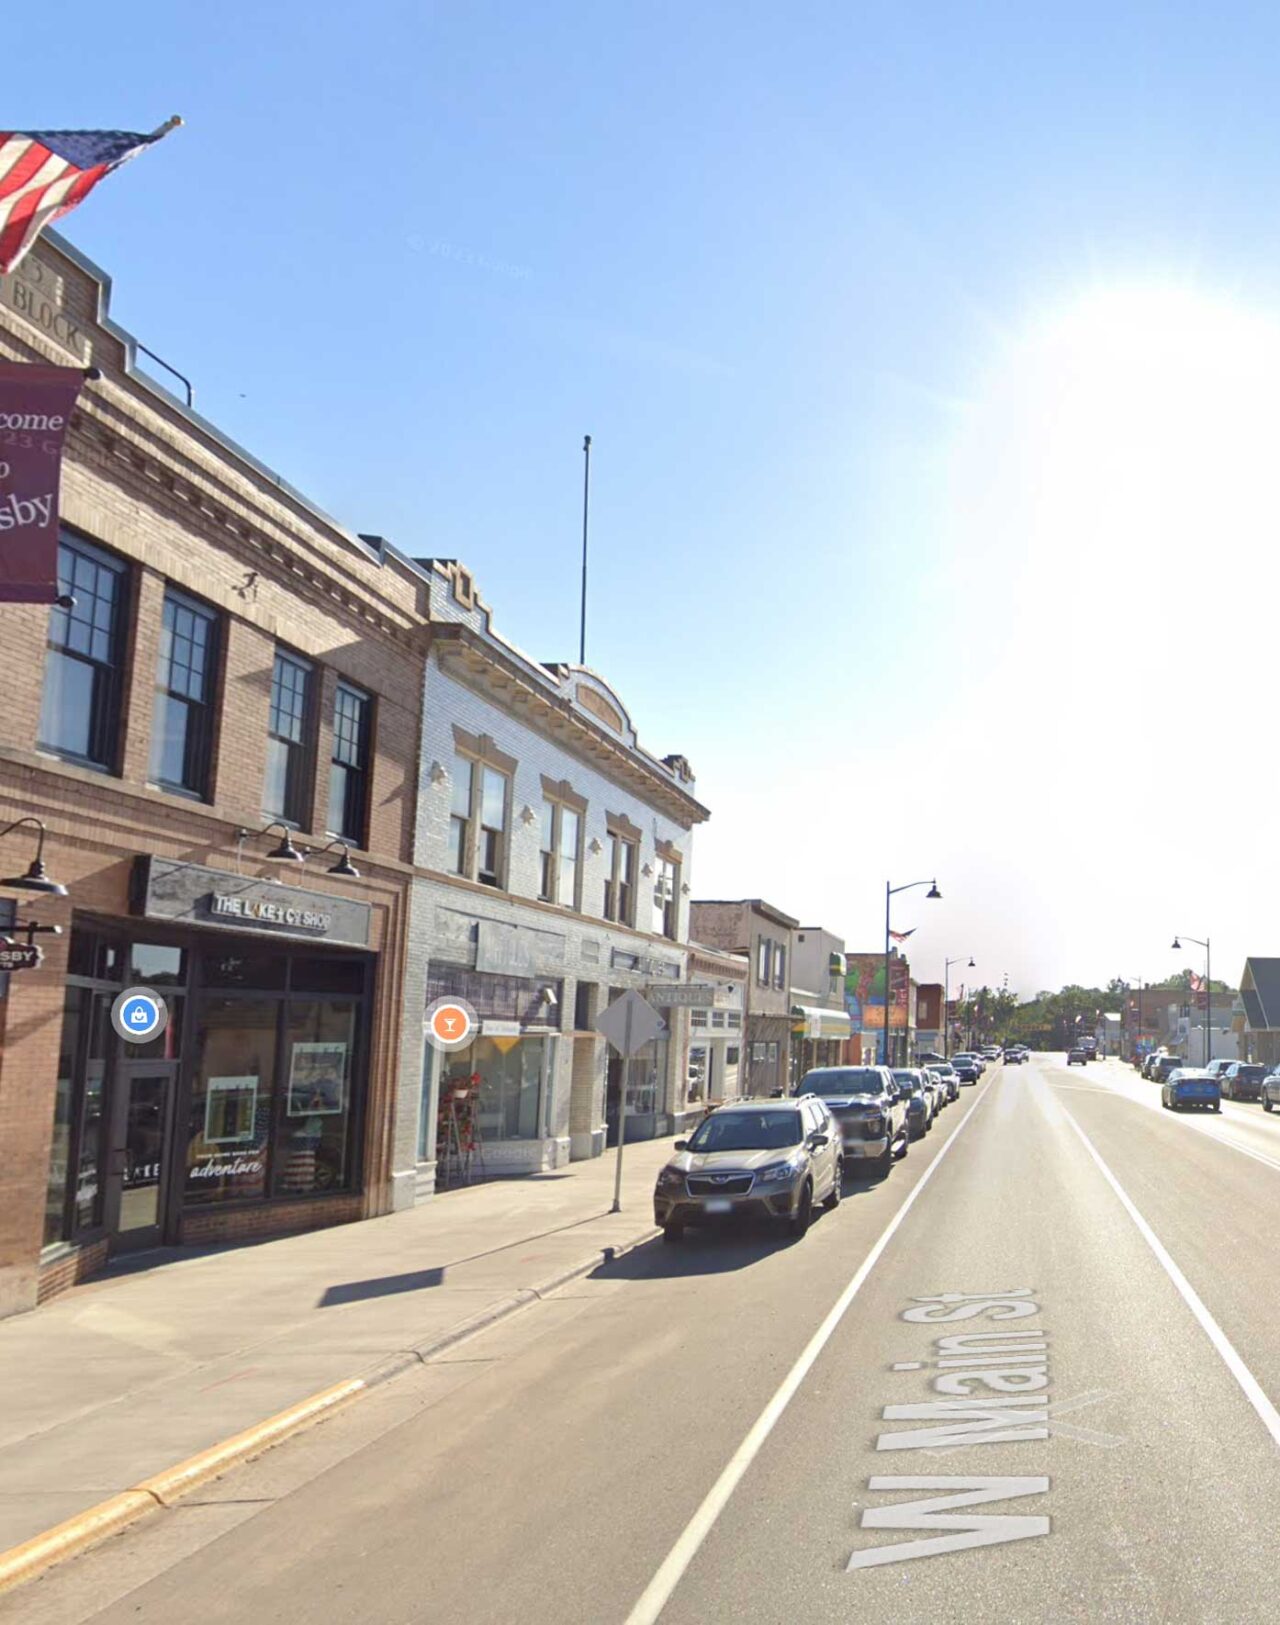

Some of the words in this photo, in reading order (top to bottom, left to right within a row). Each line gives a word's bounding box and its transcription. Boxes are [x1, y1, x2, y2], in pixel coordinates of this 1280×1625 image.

[13, 280, 82, 353] BLOCK
[216, 896, 241, 913] THE
[649, 990, 714, 1005] ANTIQUES
[190, 1157, 262, 1178] adventure
